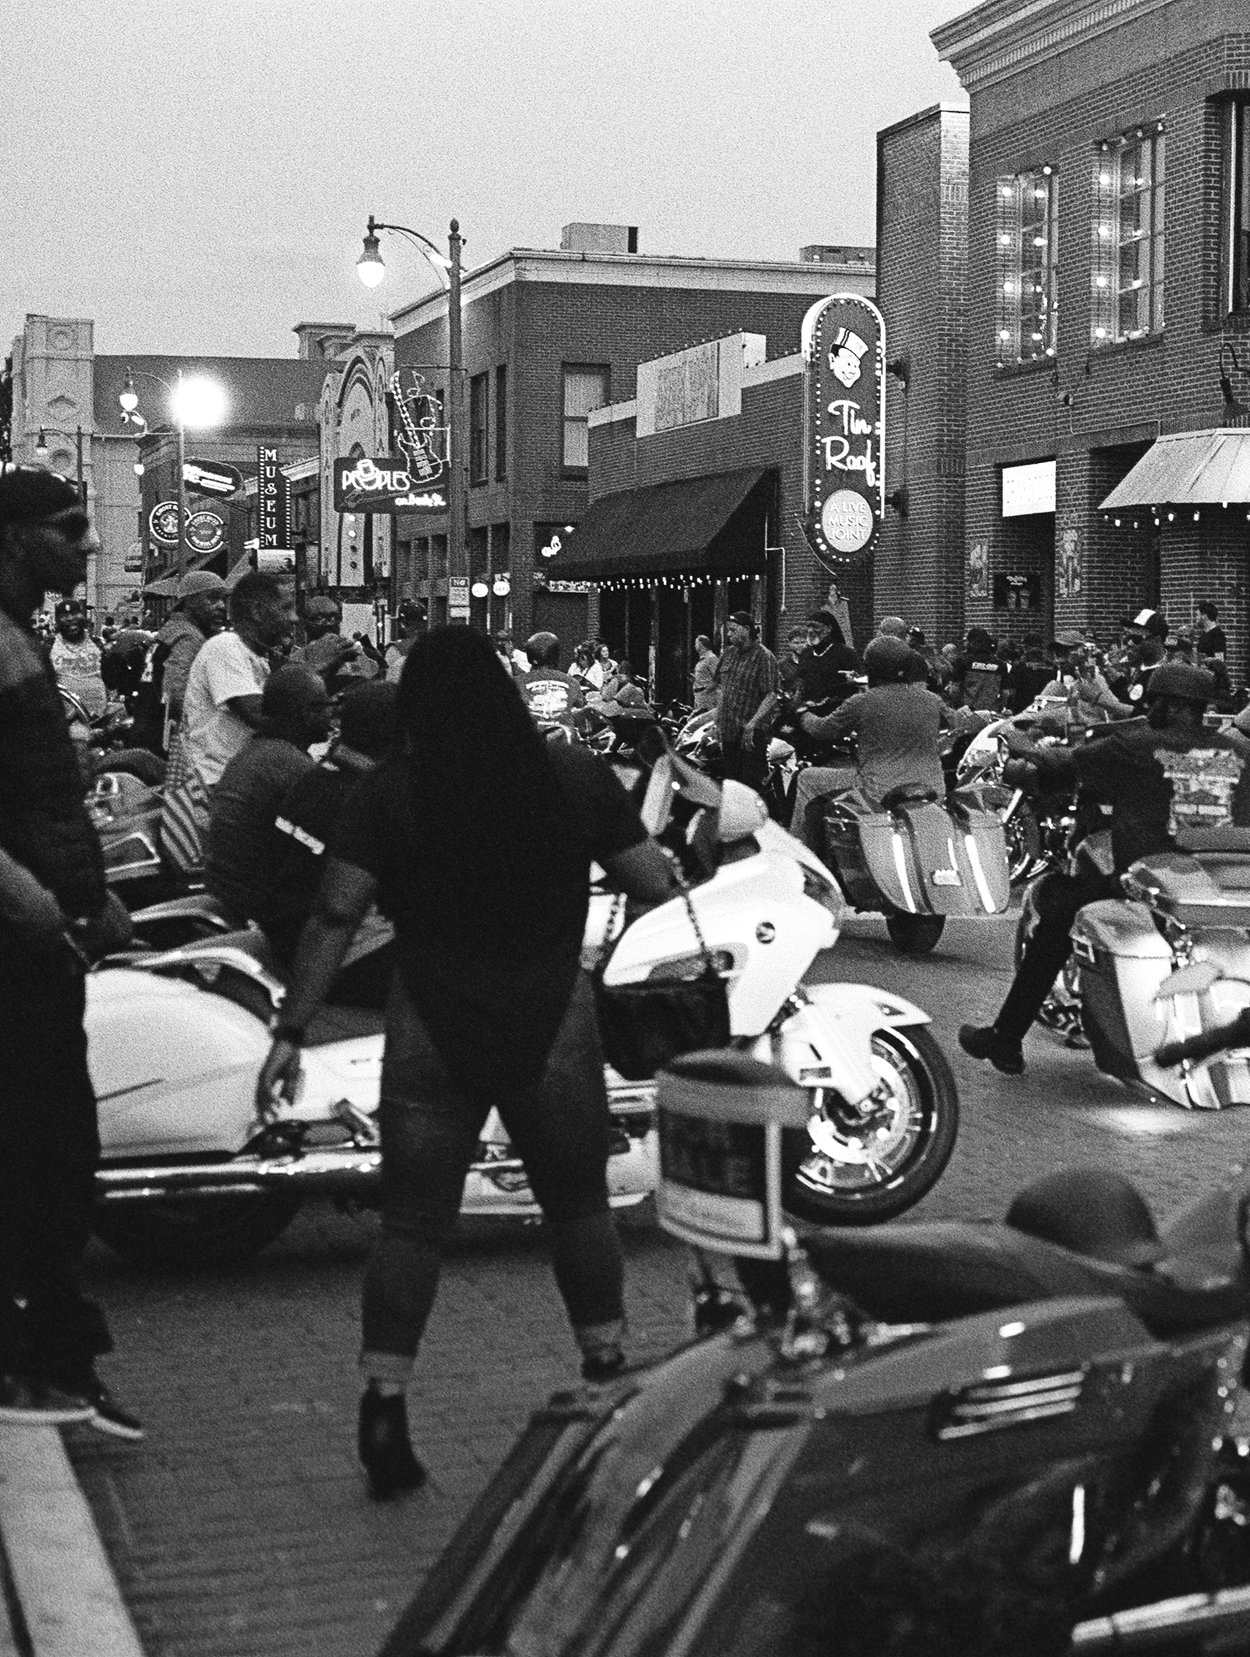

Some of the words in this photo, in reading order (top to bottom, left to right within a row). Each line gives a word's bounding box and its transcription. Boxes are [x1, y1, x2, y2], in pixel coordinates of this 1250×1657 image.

[827, 399, 872, 435] Tin
[821, 435, 877, 487] Roof
[264, 448, 278, 547] MUSEUM
[829, 502, 840, 512] A
[842, 502, 866, 513] LIVE
[827, 515, 869, 527] MUSIC
[829, 529, 867, 541] JOINT
